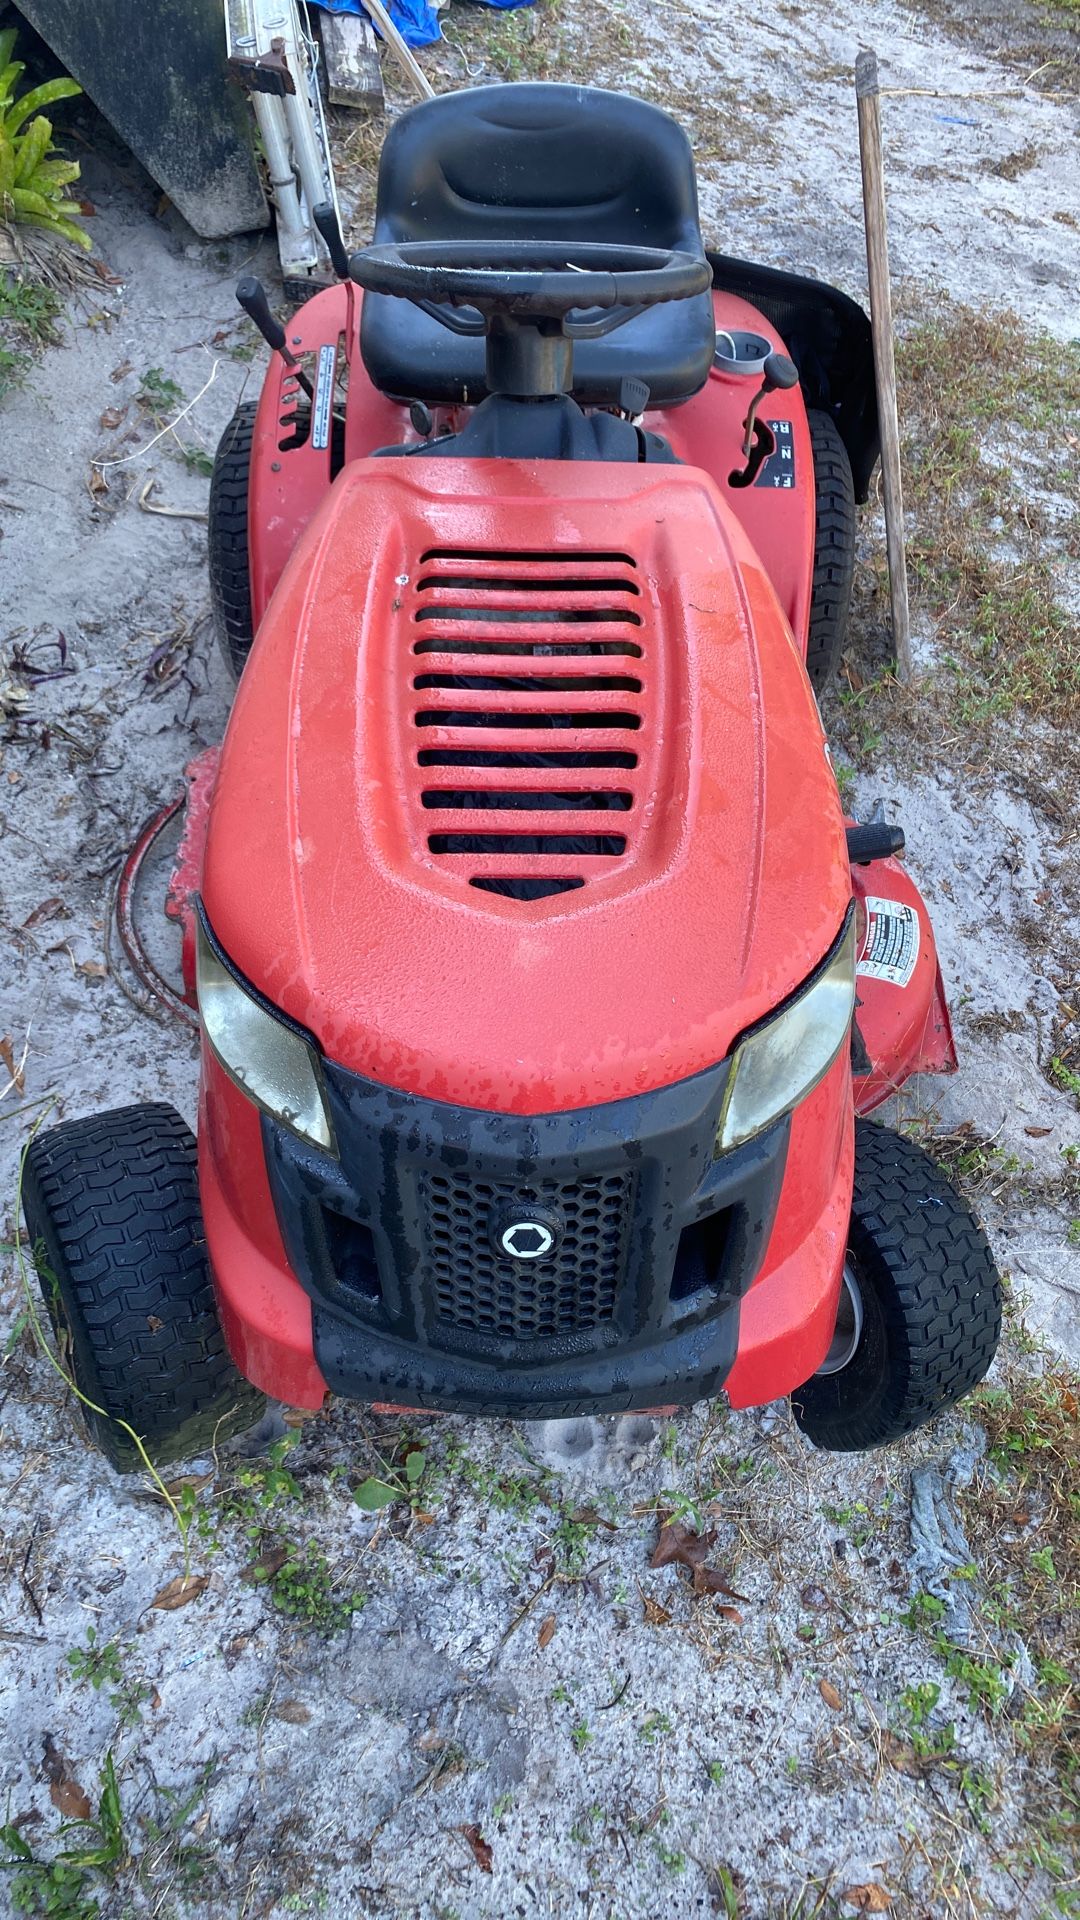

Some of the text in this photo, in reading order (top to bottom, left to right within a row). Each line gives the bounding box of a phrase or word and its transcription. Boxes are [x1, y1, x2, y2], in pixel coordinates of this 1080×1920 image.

[780, 424, 789, 433] R
[781, 449, 791, 459] N
[783, 477, 791, 487] F
